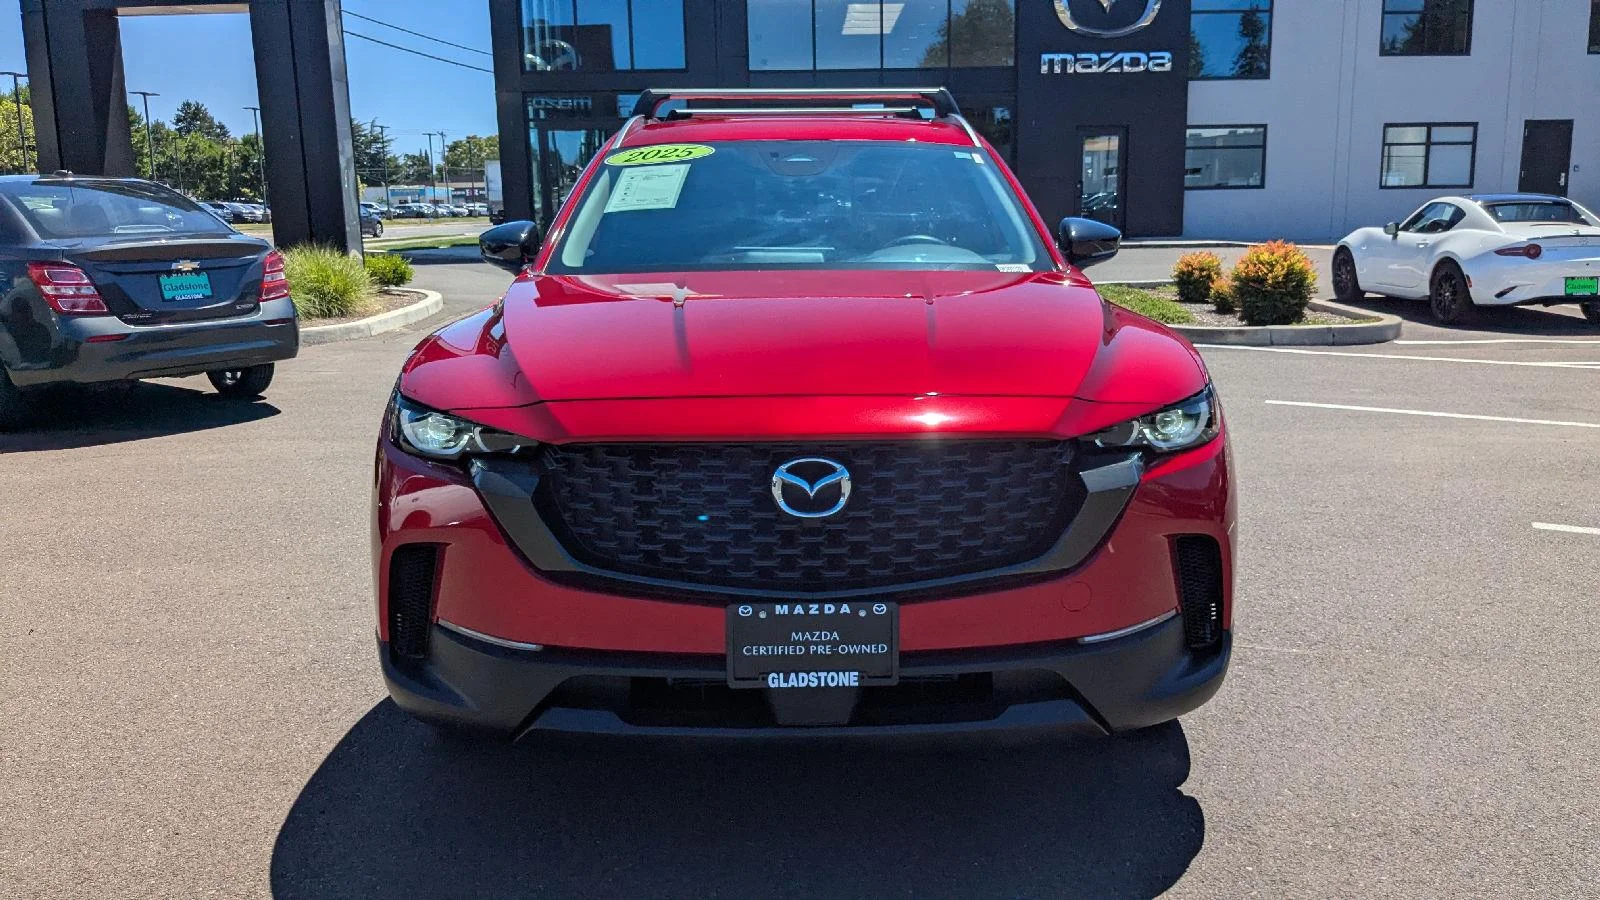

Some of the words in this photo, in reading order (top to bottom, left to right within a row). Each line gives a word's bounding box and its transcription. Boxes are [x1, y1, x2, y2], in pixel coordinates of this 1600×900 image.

[1040, 51, 1172, 74] mazda
[623, 147, 699, 163] 2025
[163, 282, 208, 292] Gladstone
[775, 603, 851, 615] MAZDA
[791, 631, 840, 642] MAZDA
[743, 645, 805, 656] CERTIFIED
[810, 643, 888, 655] PRE-OWNED
[768, 671, 859, 688] GLADSTONE
